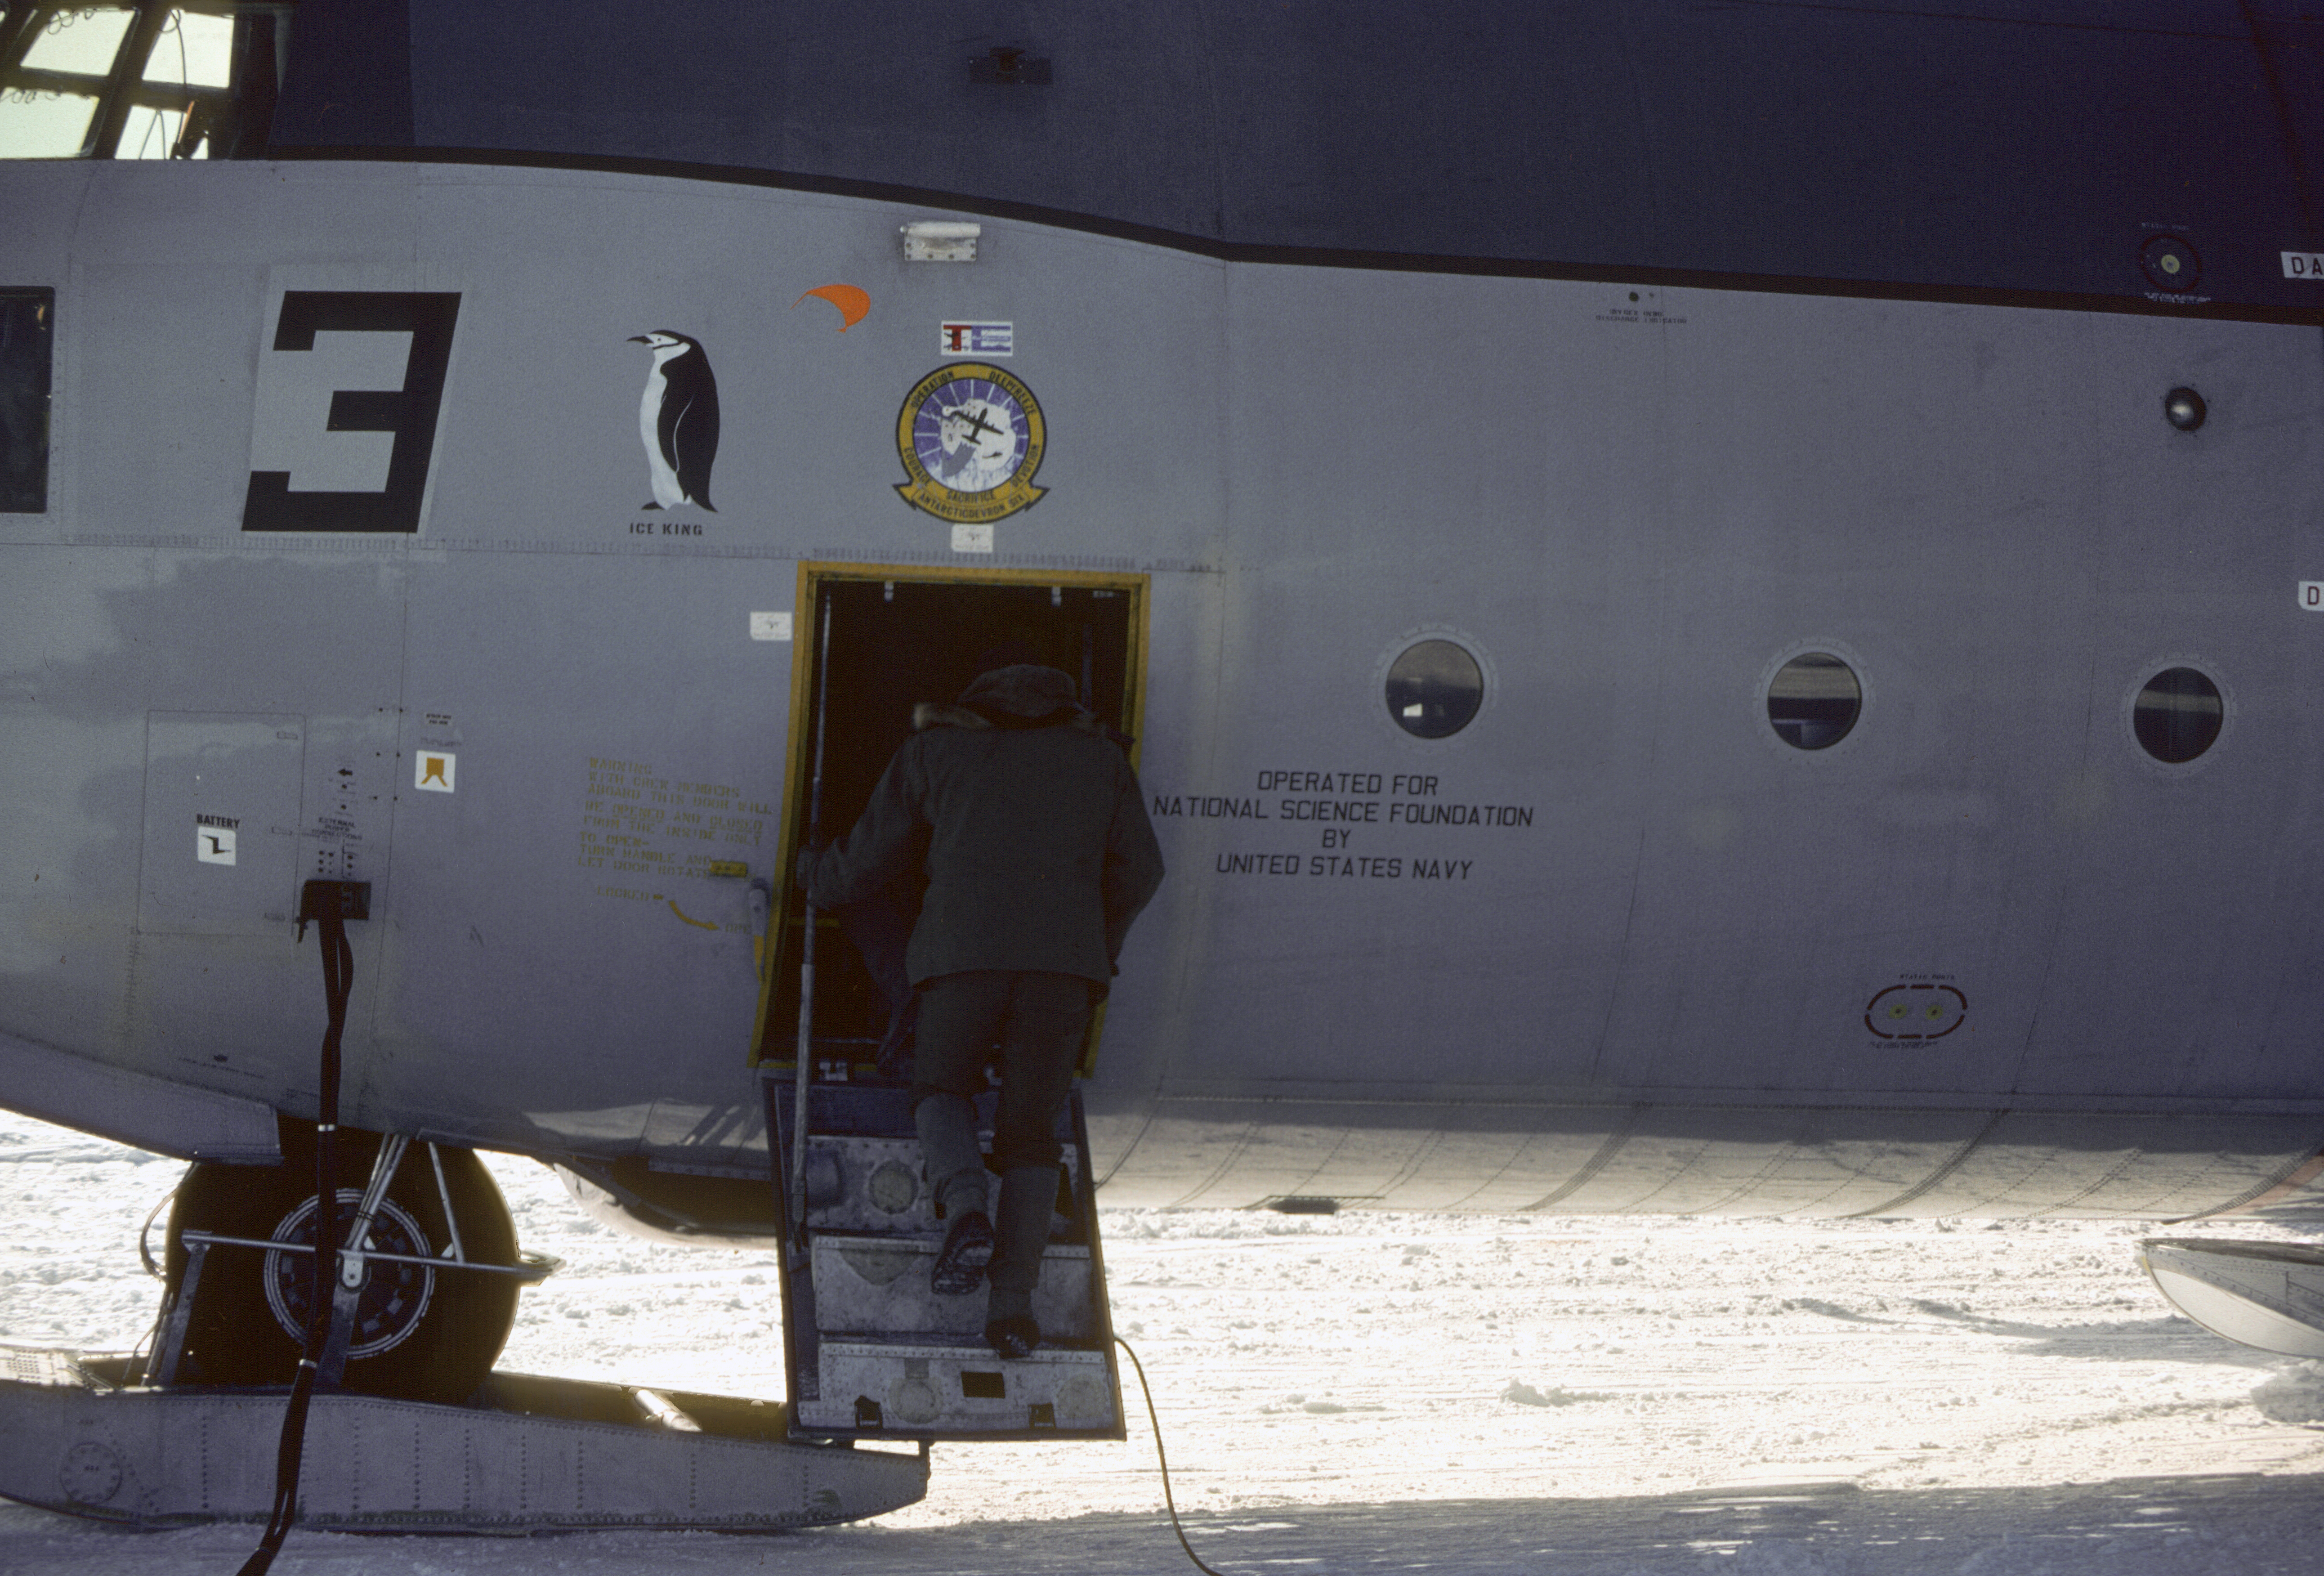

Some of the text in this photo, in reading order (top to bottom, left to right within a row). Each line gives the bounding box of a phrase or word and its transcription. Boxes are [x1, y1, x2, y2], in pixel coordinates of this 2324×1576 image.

[911, 371, 954, 409] OPERATION
[243, 291, 463, 533] 3
[904, 447, 930, 486] COURAGE
[1012, 444, 1040, 488] DEVOTION
[947, 490, 996, 503] SACRIFICE
[1009, 495, 1023, 508] SIX
[630, 522, 703, 536] ICE KING
[590, 757, 652, 775] WARNING
[589, 771, 739, 798] WITH CREW MEMBERS
[1258, 771, 1439, 796] OPERATED FOR
[588, 784, 773, 815] ABOARD THIS DOOR WILL
[1153, 795, 1534, 827] NATIONAL SCIENCE FOUNDATION
[196, 813, 241, 829] BATTERY
[585, 801, 763, 832] BE OPENED AND CLOSED
[580, 831, 597, 842] TO
[583, 816, 761, 846] FROM THE INSIDE ONLY
[1322, 828, 1352, 849] BY
[578, 857, 605, 868] LET
[614, 861, 650, 873] DOOR
[580, 844, 711, 865] TURN HANDLE AND
[1217, 854, 1473, 880] UNITED STATES NAVY
[597, 886, 649, 901] LOCKED
